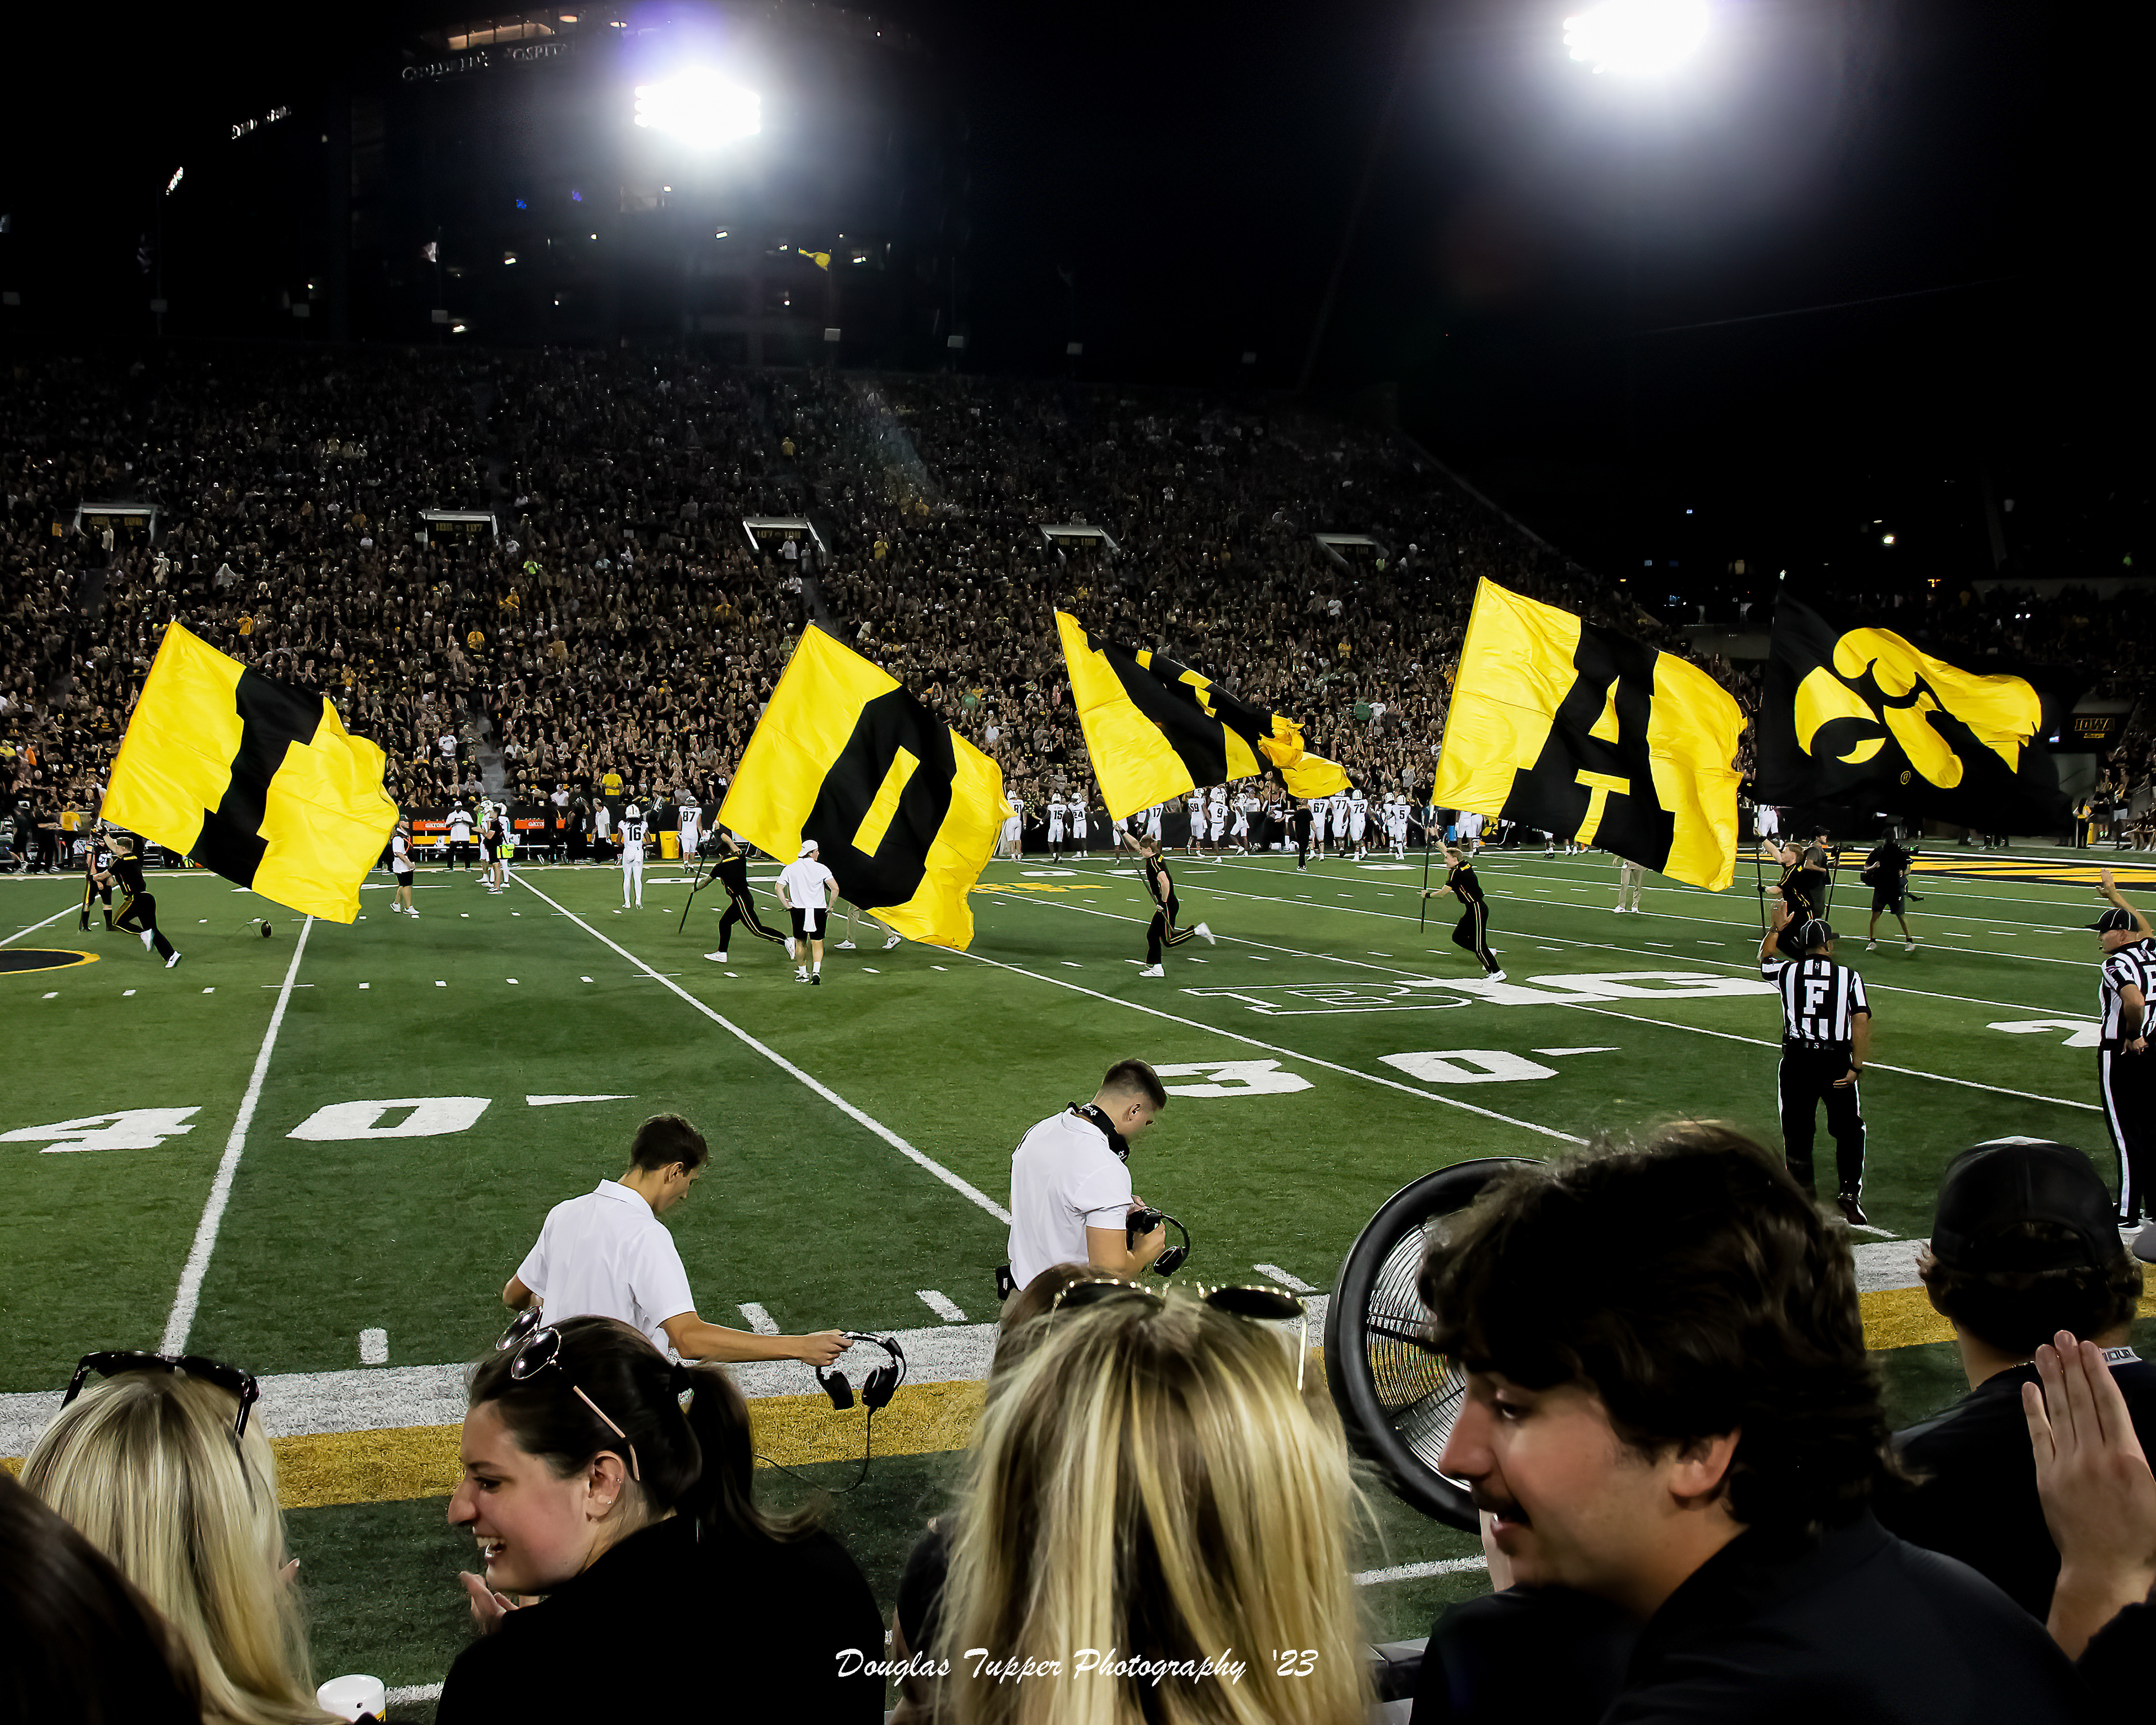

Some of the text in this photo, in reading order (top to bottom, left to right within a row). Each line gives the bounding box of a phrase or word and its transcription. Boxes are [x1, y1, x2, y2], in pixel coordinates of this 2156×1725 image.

[1499, 616, 1675, 874] A
[188, 667, 324, 888] I
[801, 684, 957, 910] O
[1313, 803, 1325, 813] 67
[1335, 800, 1347, 810] 77
[1354, 804, 1365, 814] 72
[682, 811, 696, 822] 87
[1053, 810, 1063, 820] 15
[1153, 807, 1161, 818] 17
[1217, 808, 1223, 818] 9
[1399, 809, 1405, 819] 5
[627, 827, 641, 841] 16
[1803, 979, 1830, 1015] F
